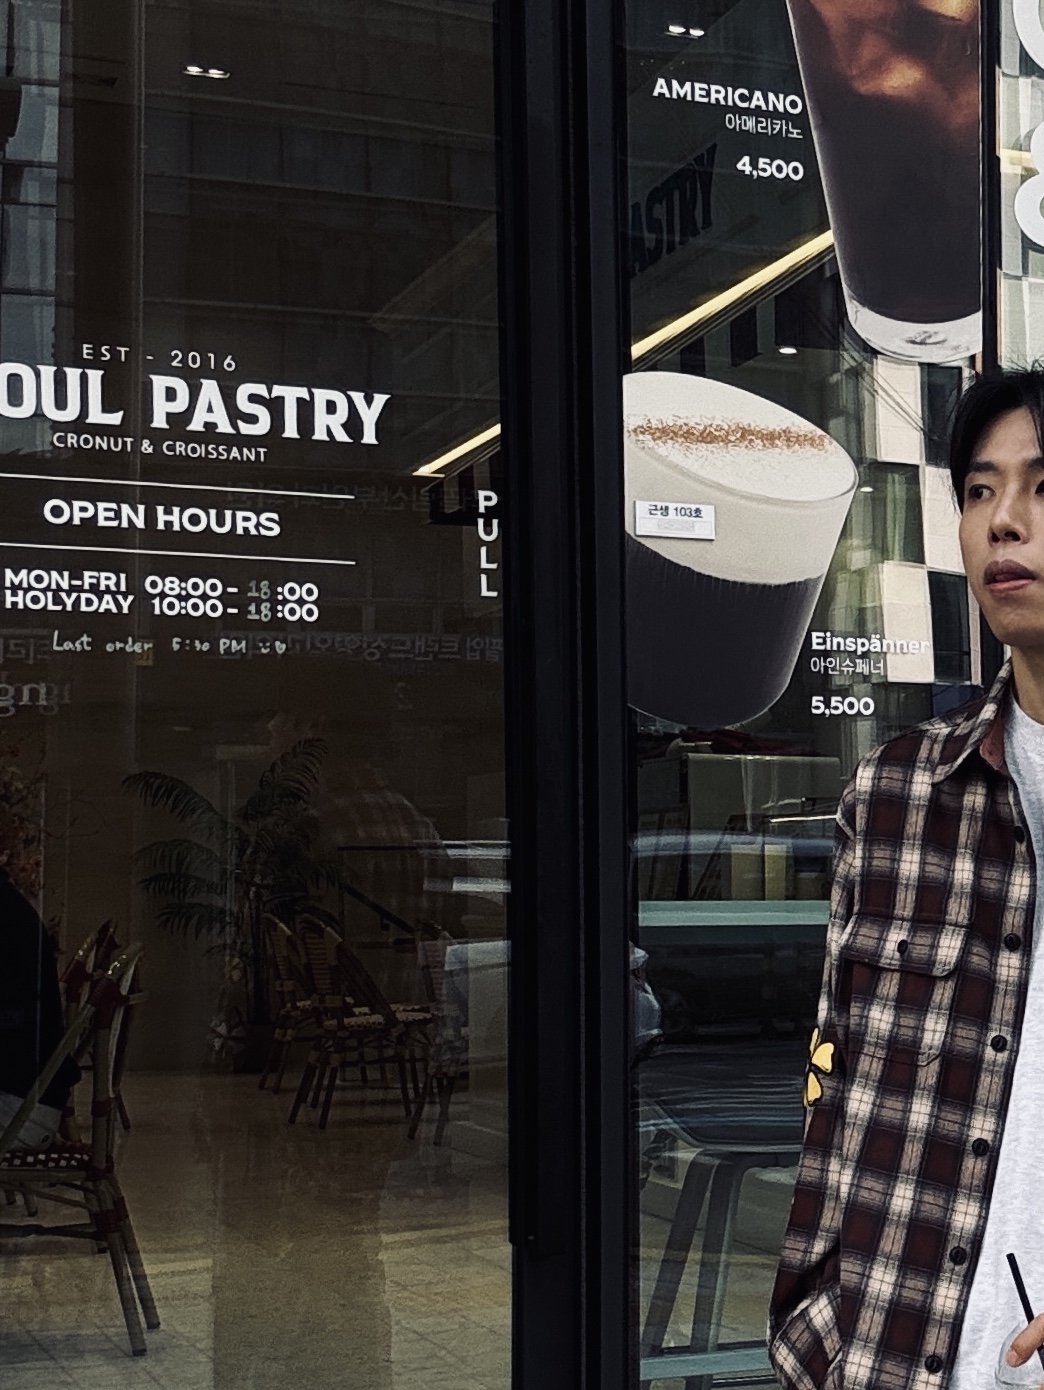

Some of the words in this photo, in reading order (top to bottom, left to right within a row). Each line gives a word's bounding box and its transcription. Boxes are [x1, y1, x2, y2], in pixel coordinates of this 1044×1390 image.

[653, 78, 803, 115] AMERICANO
[726, 113, 804, 139] 아메리카노
[736, 155, 804, 181] 4,500
[82, 344, 129, 361] EST
[171, 350, 236, 371] 2016
[149, 374, 391, 444] PASTRY
[53, 432, 133, 453] CRONUT
[141, 439, 153, 453] &
[163, 441, 267, 462] CROISSANT
[44, 499, 145, 529] OPEN
[156, 506, 281, 536] HOURS
[477, 490, 499, 597] PULL
[4, 569, 126, 591] MON-FRI
[5, 590, 134, 614] HOLYDAY
[53, 630, 92, 651] Last
[105, 637, 153, 653] order
[219, 639, 246, 654] PM
[811, 631, 931, 656] Einspänner
[810, 657, 884, 676] 아인슈페너
[811, 696, 875, 717] 5,500
